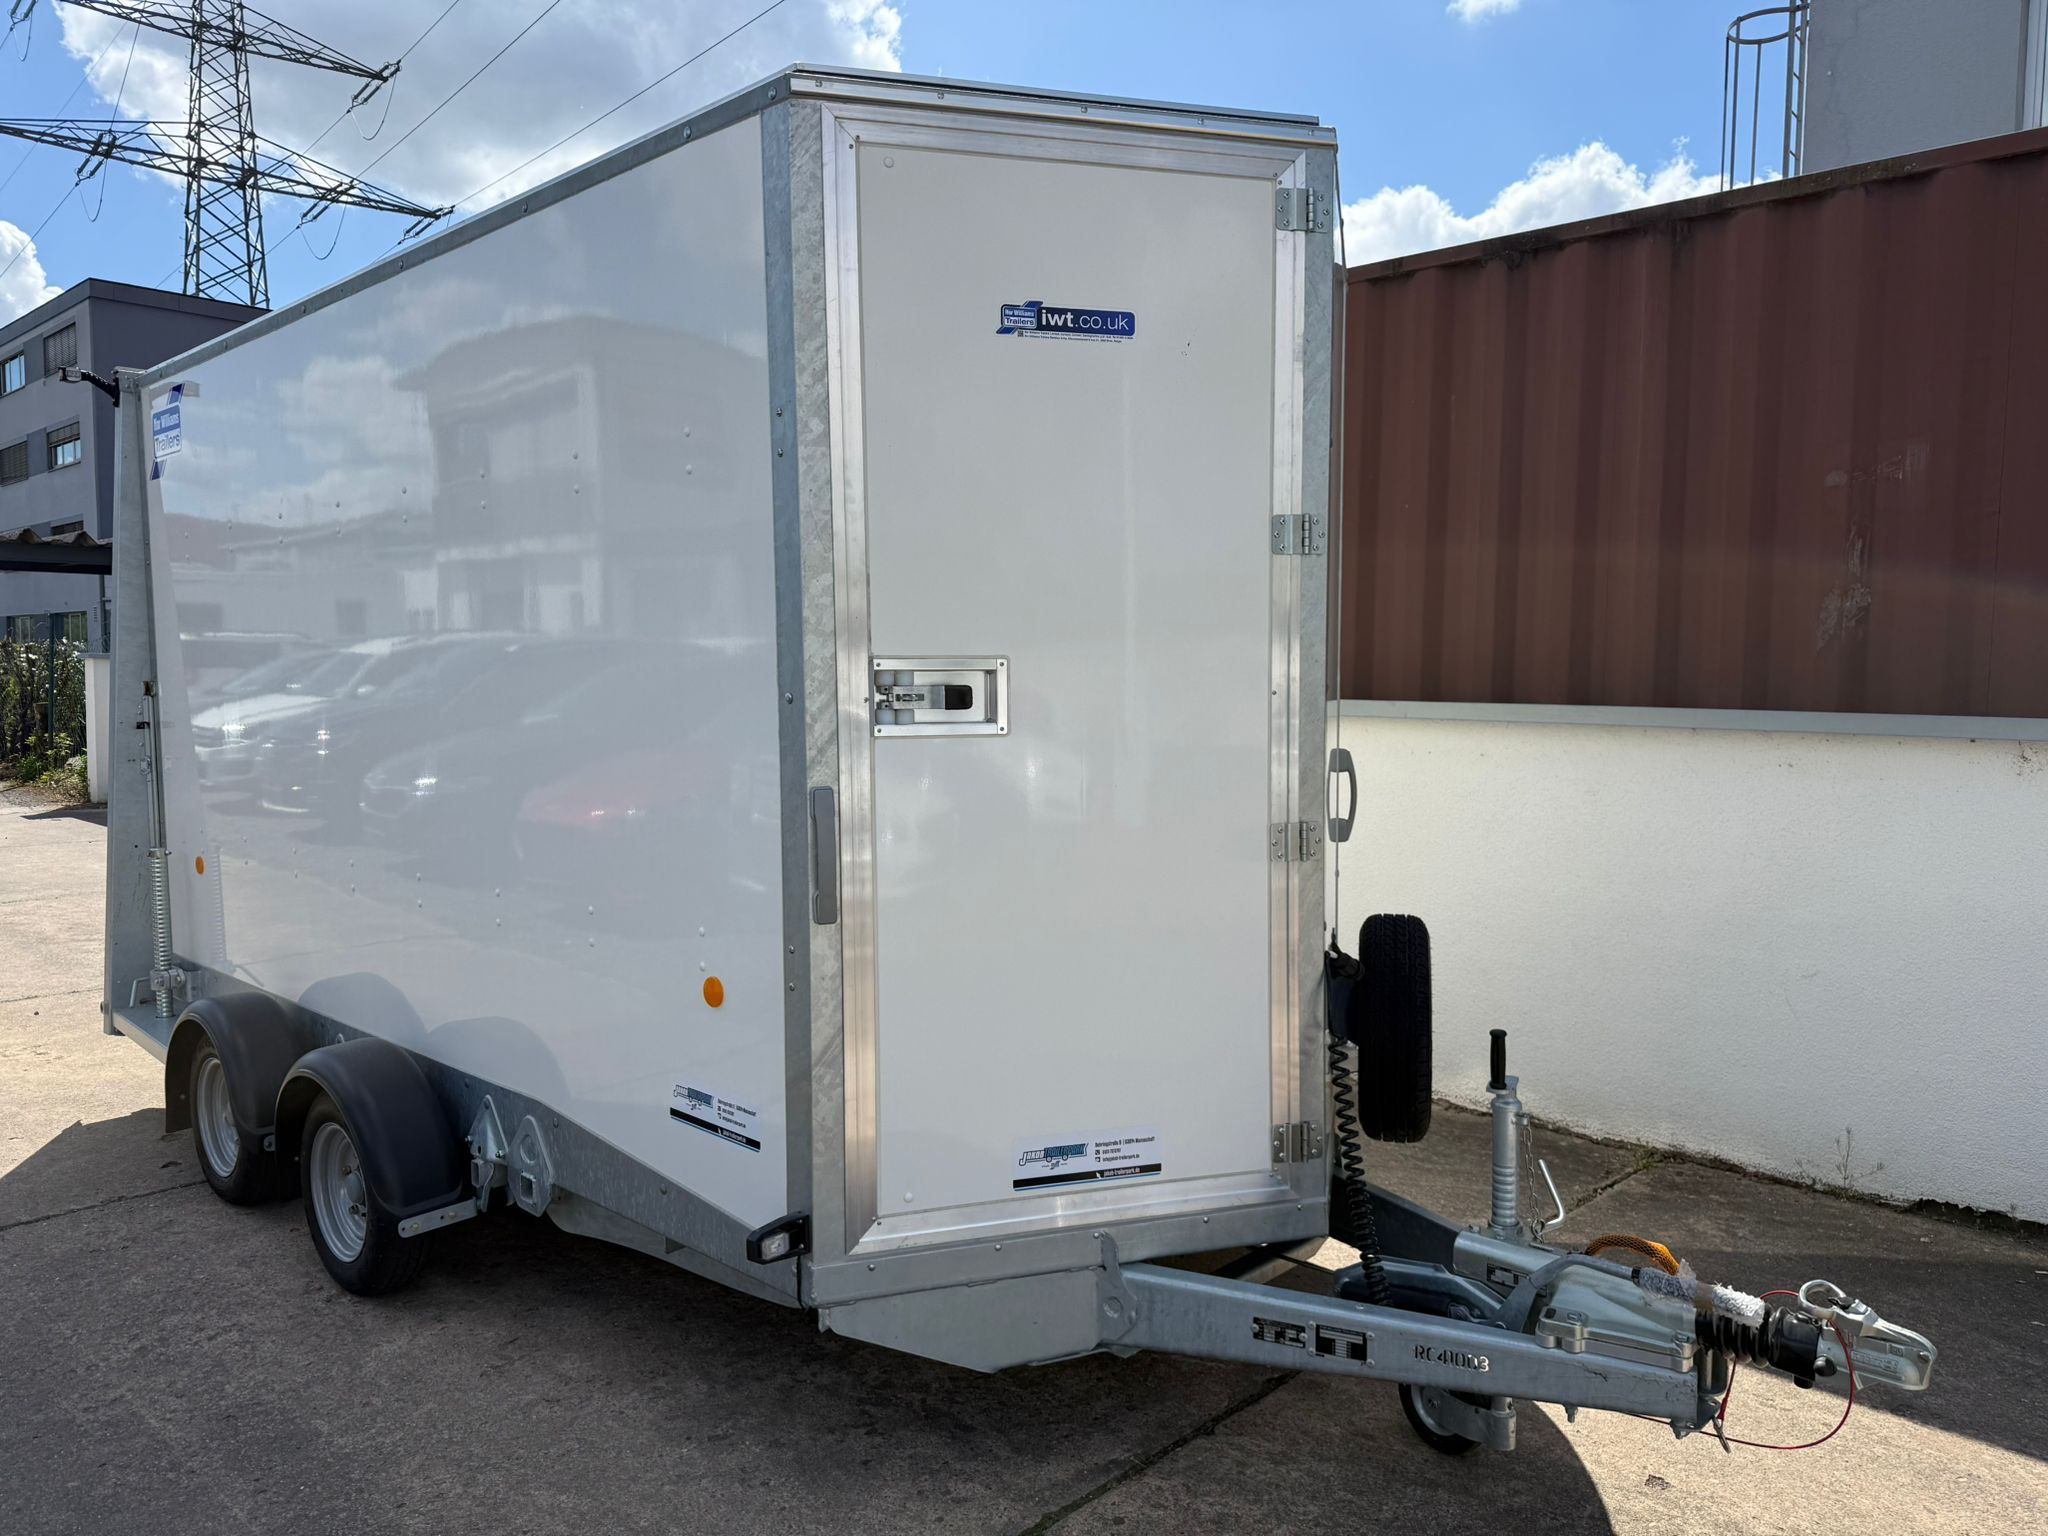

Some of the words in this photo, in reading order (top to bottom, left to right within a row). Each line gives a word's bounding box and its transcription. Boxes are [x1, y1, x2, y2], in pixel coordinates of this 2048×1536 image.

[1005, 317, 1035, 327] Trailers
[1041, 309, 1129, 331] iwt.co.uk
[155, 433, 180, 453] Trailers
